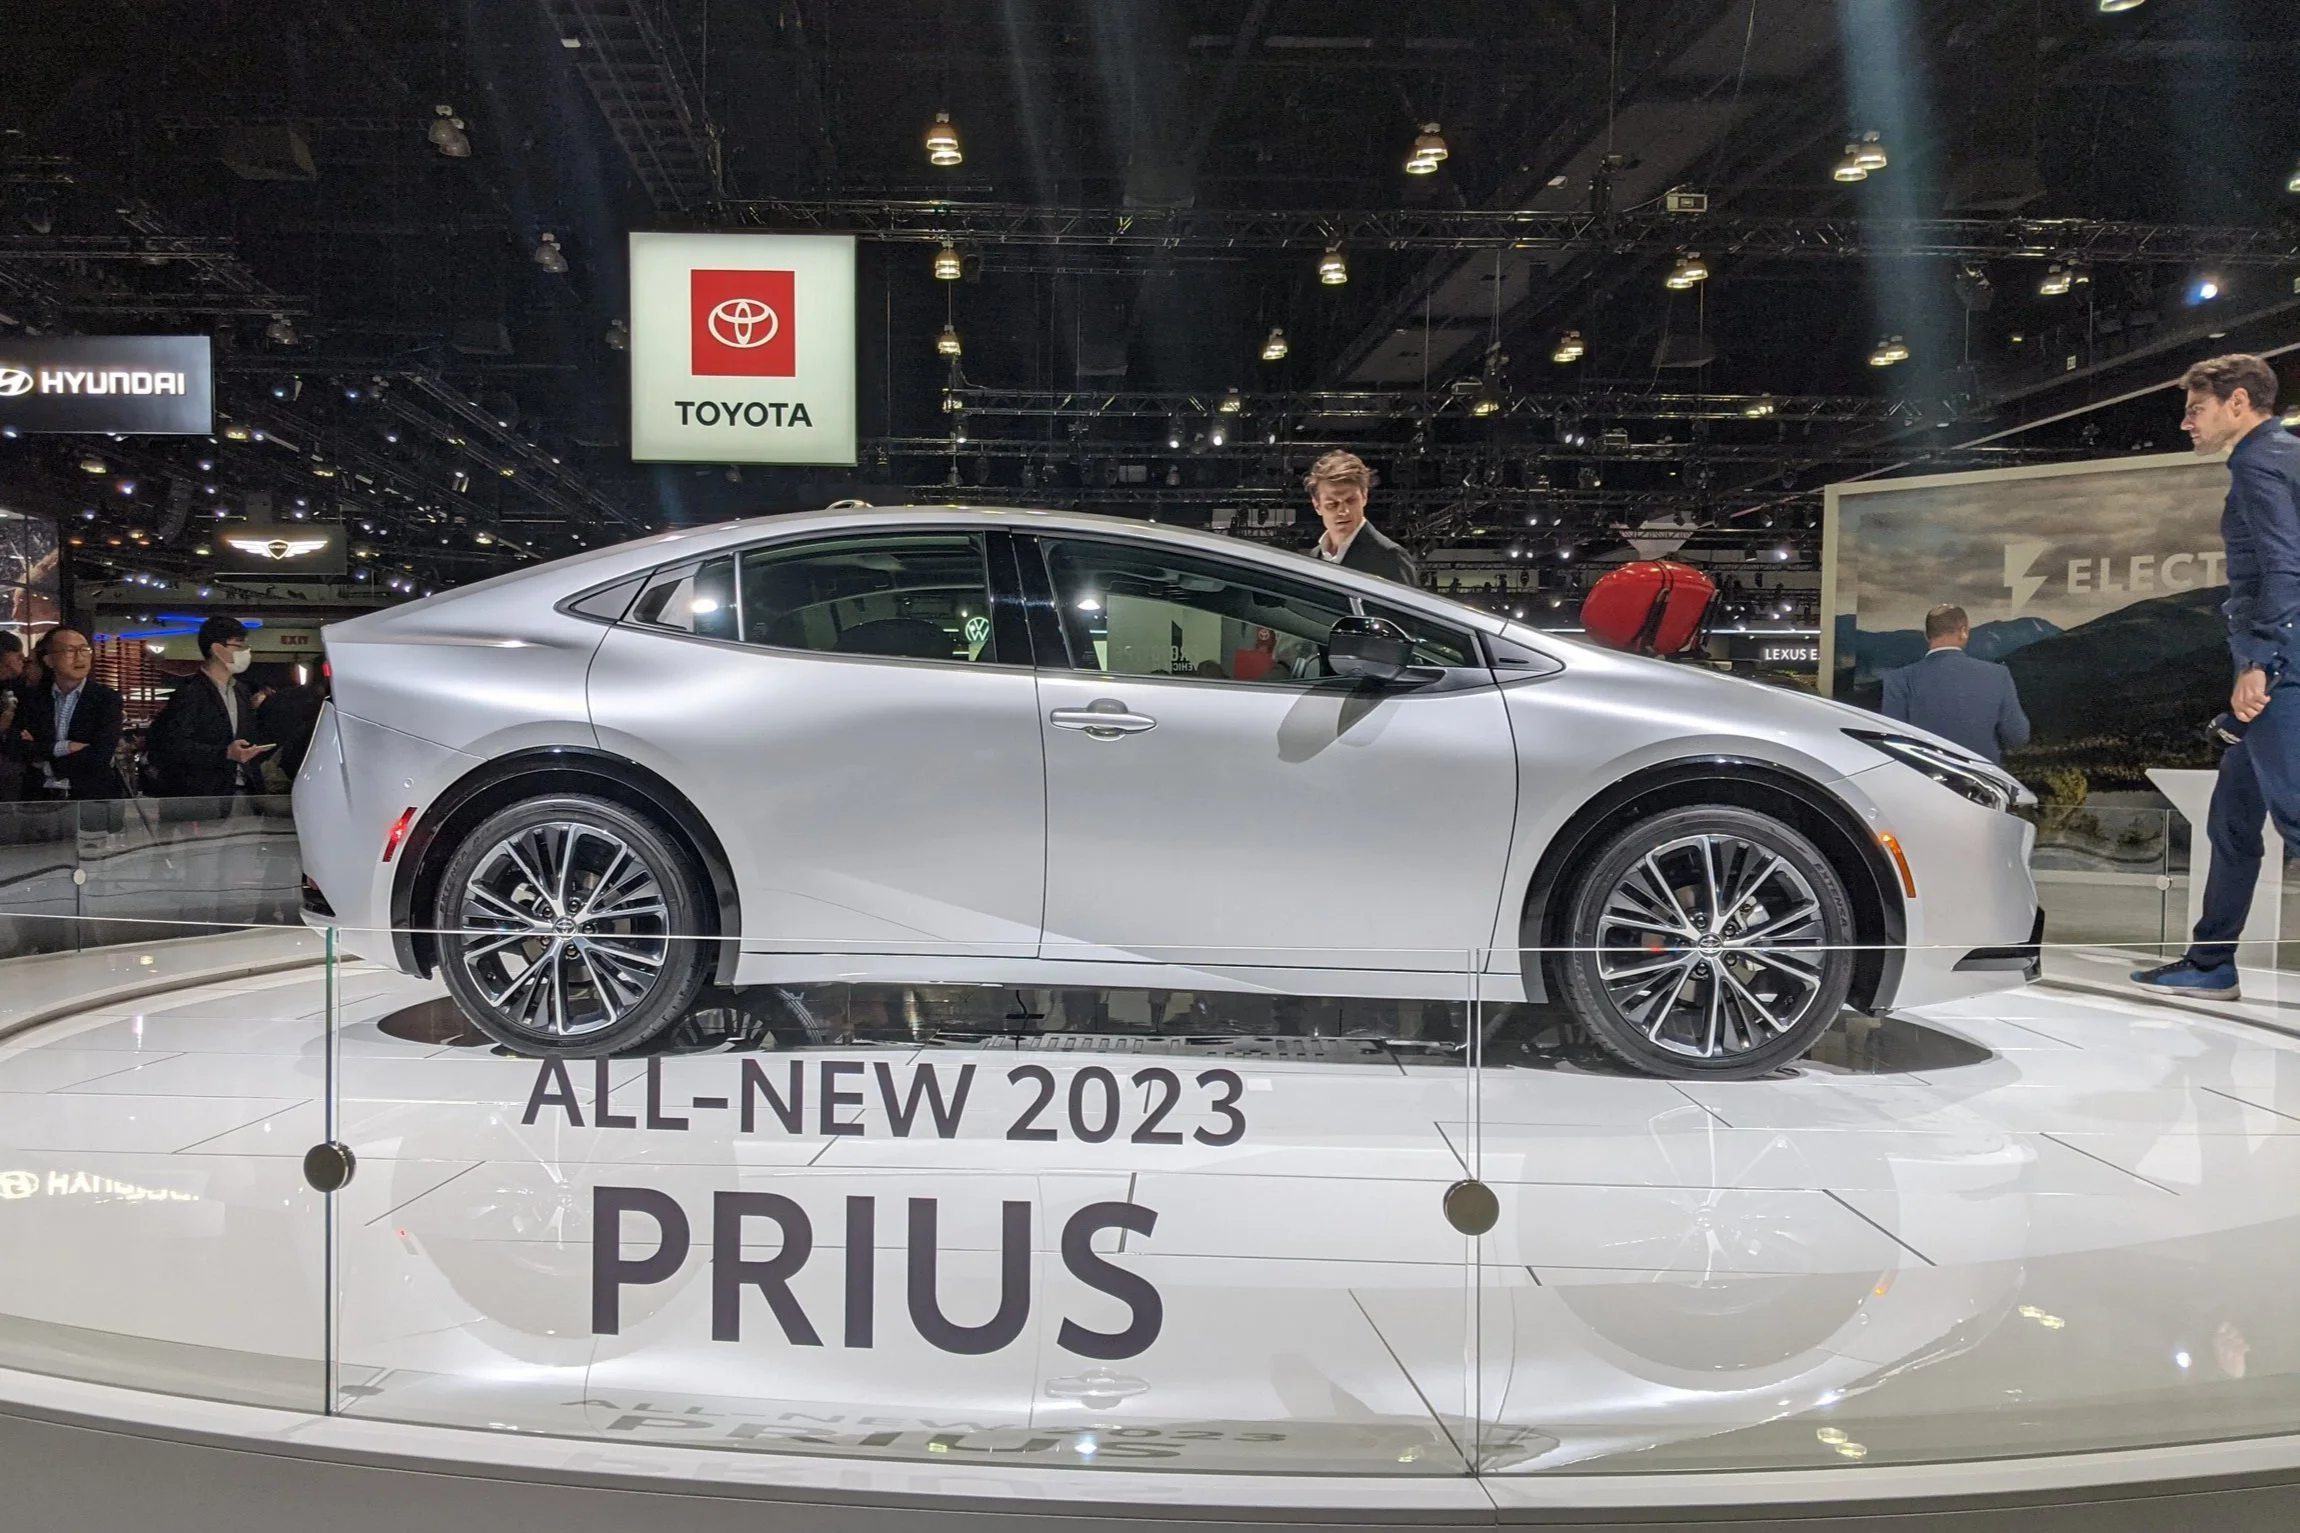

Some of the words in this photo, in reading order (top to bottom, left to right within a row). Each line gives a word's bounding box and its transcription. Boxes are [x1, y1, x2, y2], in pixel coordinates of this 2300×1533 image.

[41, 371, 185, 395] HYUNDAI
[675, 400, 813, 427] TOYOTA
[1765, 648, 1807, 661] LEXUS
[520, 1053, 977, 1140] ALL-NEW
[1005, 1065, 1247, 1147] 2023
[592, 1185, 1164, 1361] PRIUS
